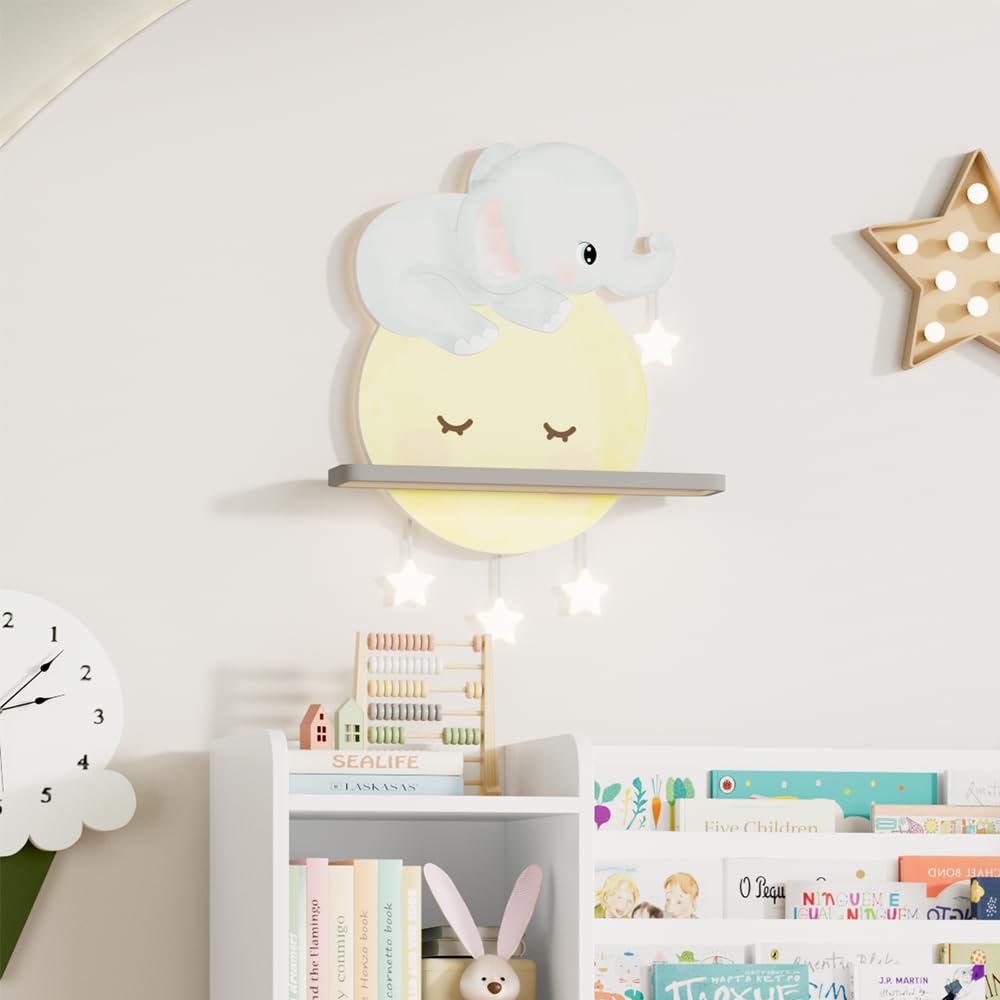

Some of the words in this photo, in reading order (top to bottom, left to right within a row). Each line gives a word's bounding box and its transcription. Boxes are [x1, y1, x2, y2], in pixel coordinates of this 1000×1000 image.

[2, 612, 14, 628] 2
[51, 626, 58, 642] 1
[80, 665, 92, 681] 2
[93, 709, 104, 724] 3
[77, 754, 89, 770] 4
[332, 754, 419, 769] SEALIFE
[41, 787, 52, 803] 5
[704, 820, 734, 832] Five
[743, 820, 818, 832] Children
[739, 876, 751, 898] O
[755, 876, 786, 904] Pequ
[360, 911, 369, 940] book
[384, 902, 393, 933] book
[309, 899, 320, 958] Flamingo
[337, 915, 348, 983] conmigo
[309, 961, 319, 982] the
[385, 939, 393, 999] cornetto
[879, 977, 892, 985] J.P.
[895, 977, 929, 985] MARTIN
